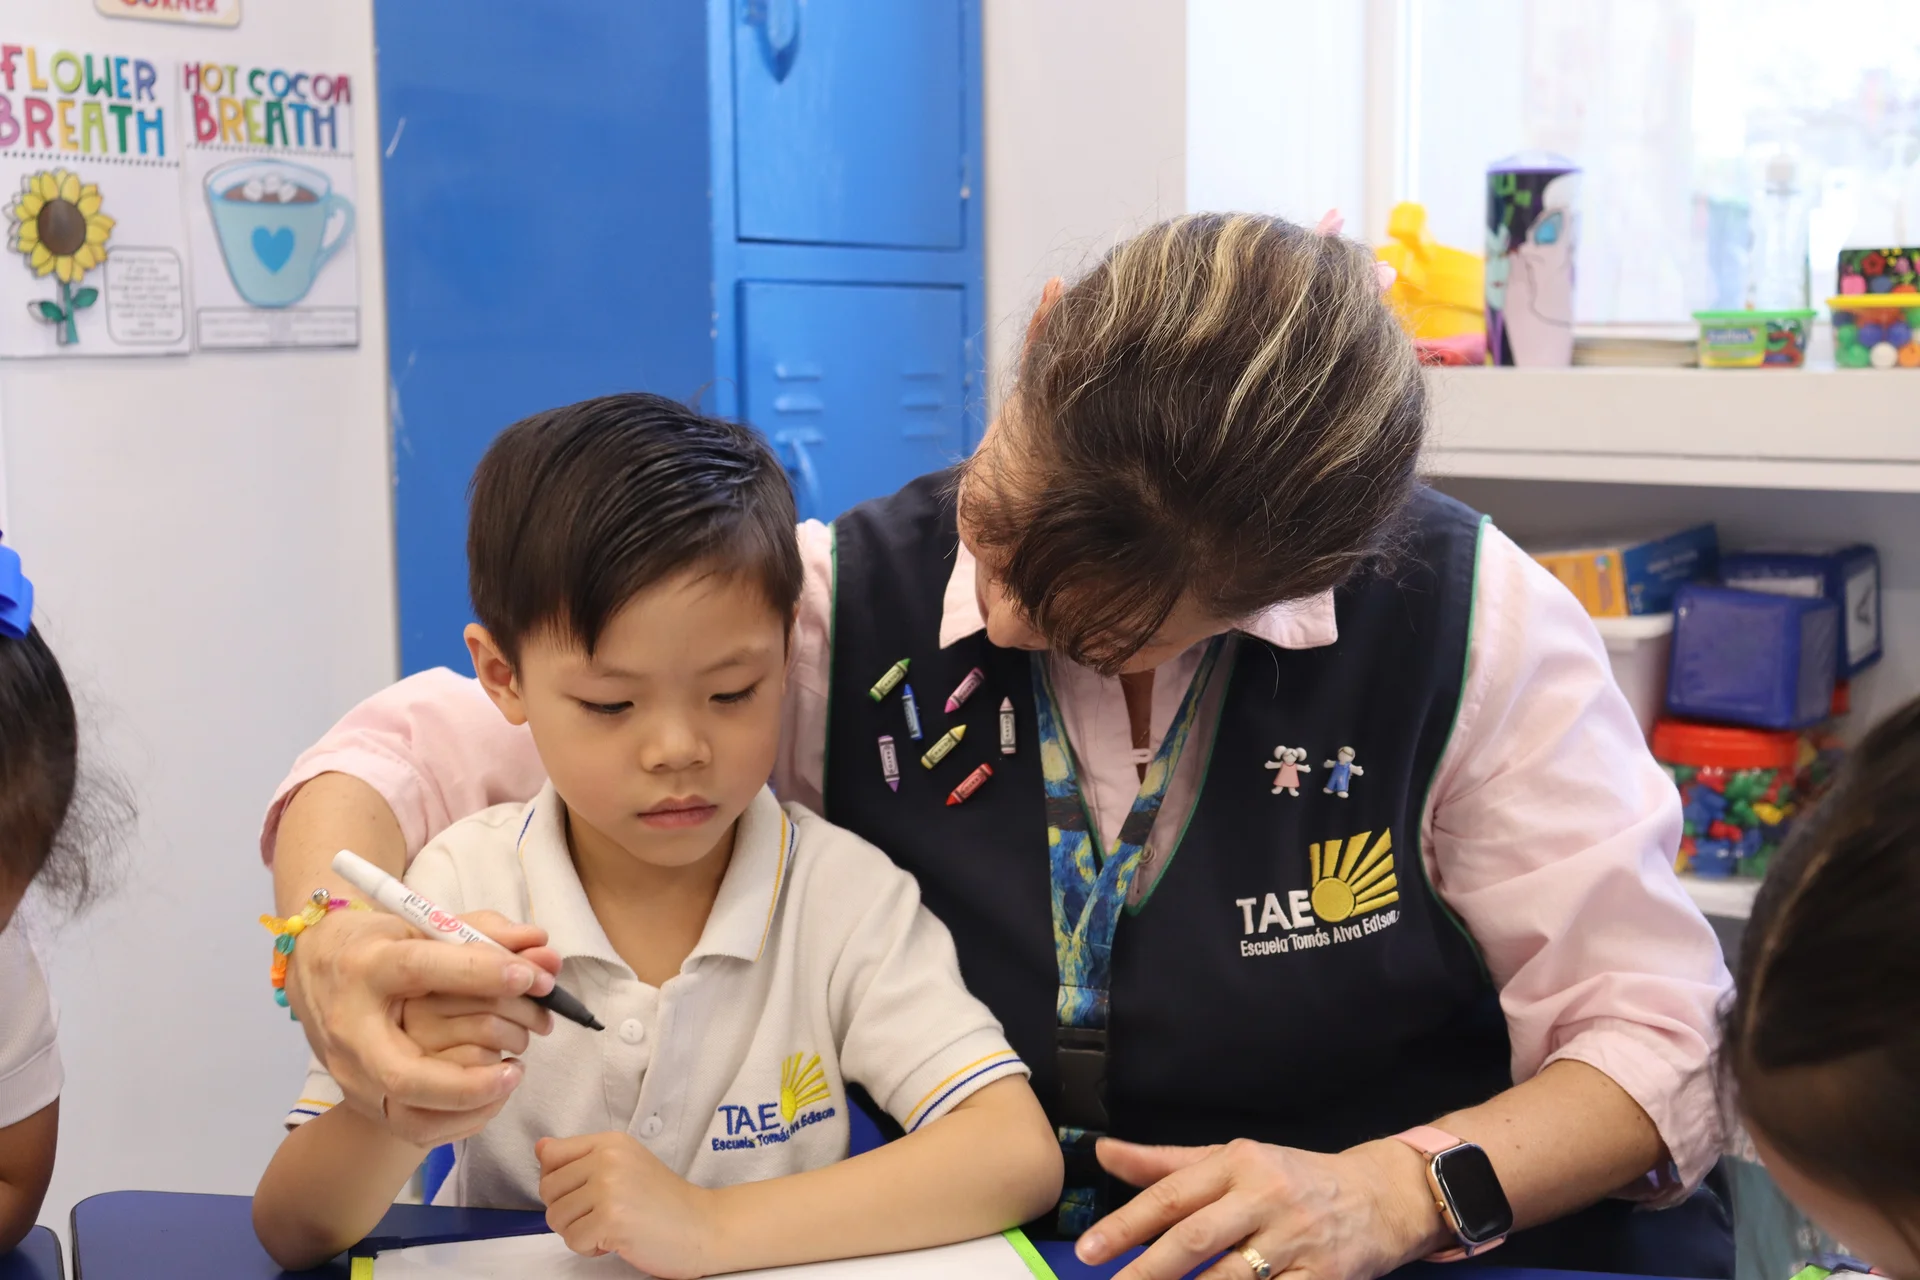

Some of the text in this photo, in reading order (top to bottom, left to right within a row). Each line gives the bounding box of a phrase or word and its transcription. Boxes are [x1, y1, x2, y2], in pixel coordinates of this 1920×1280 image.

[1, 44, 157, 102] FLOWER
[182, 62, 351, 105] HOT COCOA
[0, 95, 165, 157] BREATH
[192, 94, 338, 149] BREATH
[1235, 889, 1316, 935] TAE
[1240, 910, 1400, 957] Escuela Tomás Alva Edison
[717, 1102, 781, 1136] TAE
[712, 1136, 756, 1151] Escuela
